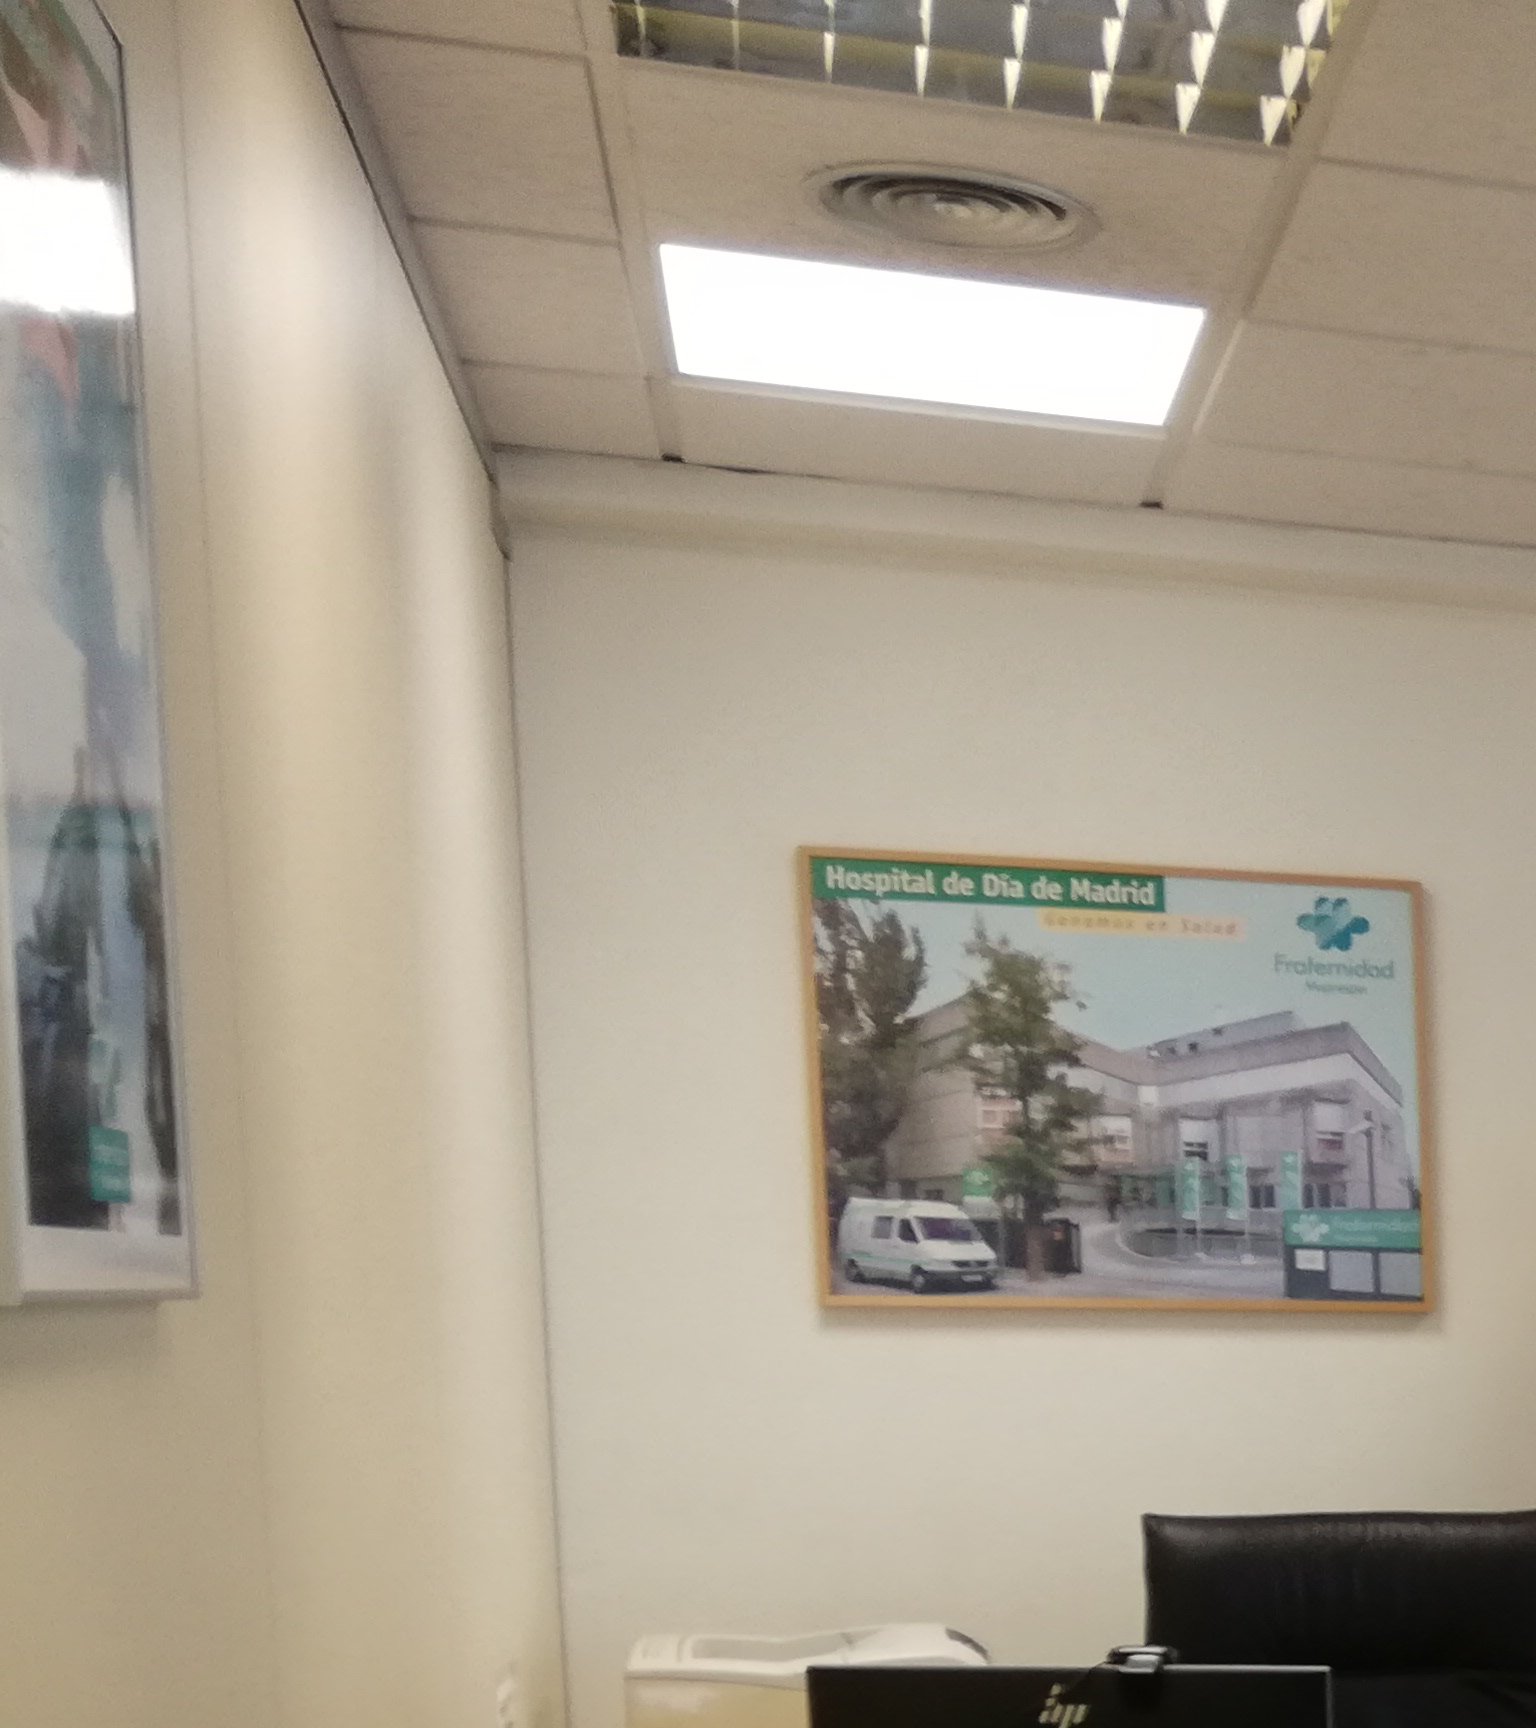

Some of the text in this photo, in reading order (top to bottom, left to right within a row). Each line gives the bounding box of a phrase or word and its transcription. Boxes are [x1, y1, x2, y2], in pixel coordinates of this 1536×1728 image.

[826, 865, 1156, 906] Hospital de Día de Madrid
[1274, 953, 1395, 979] Fraternidad
